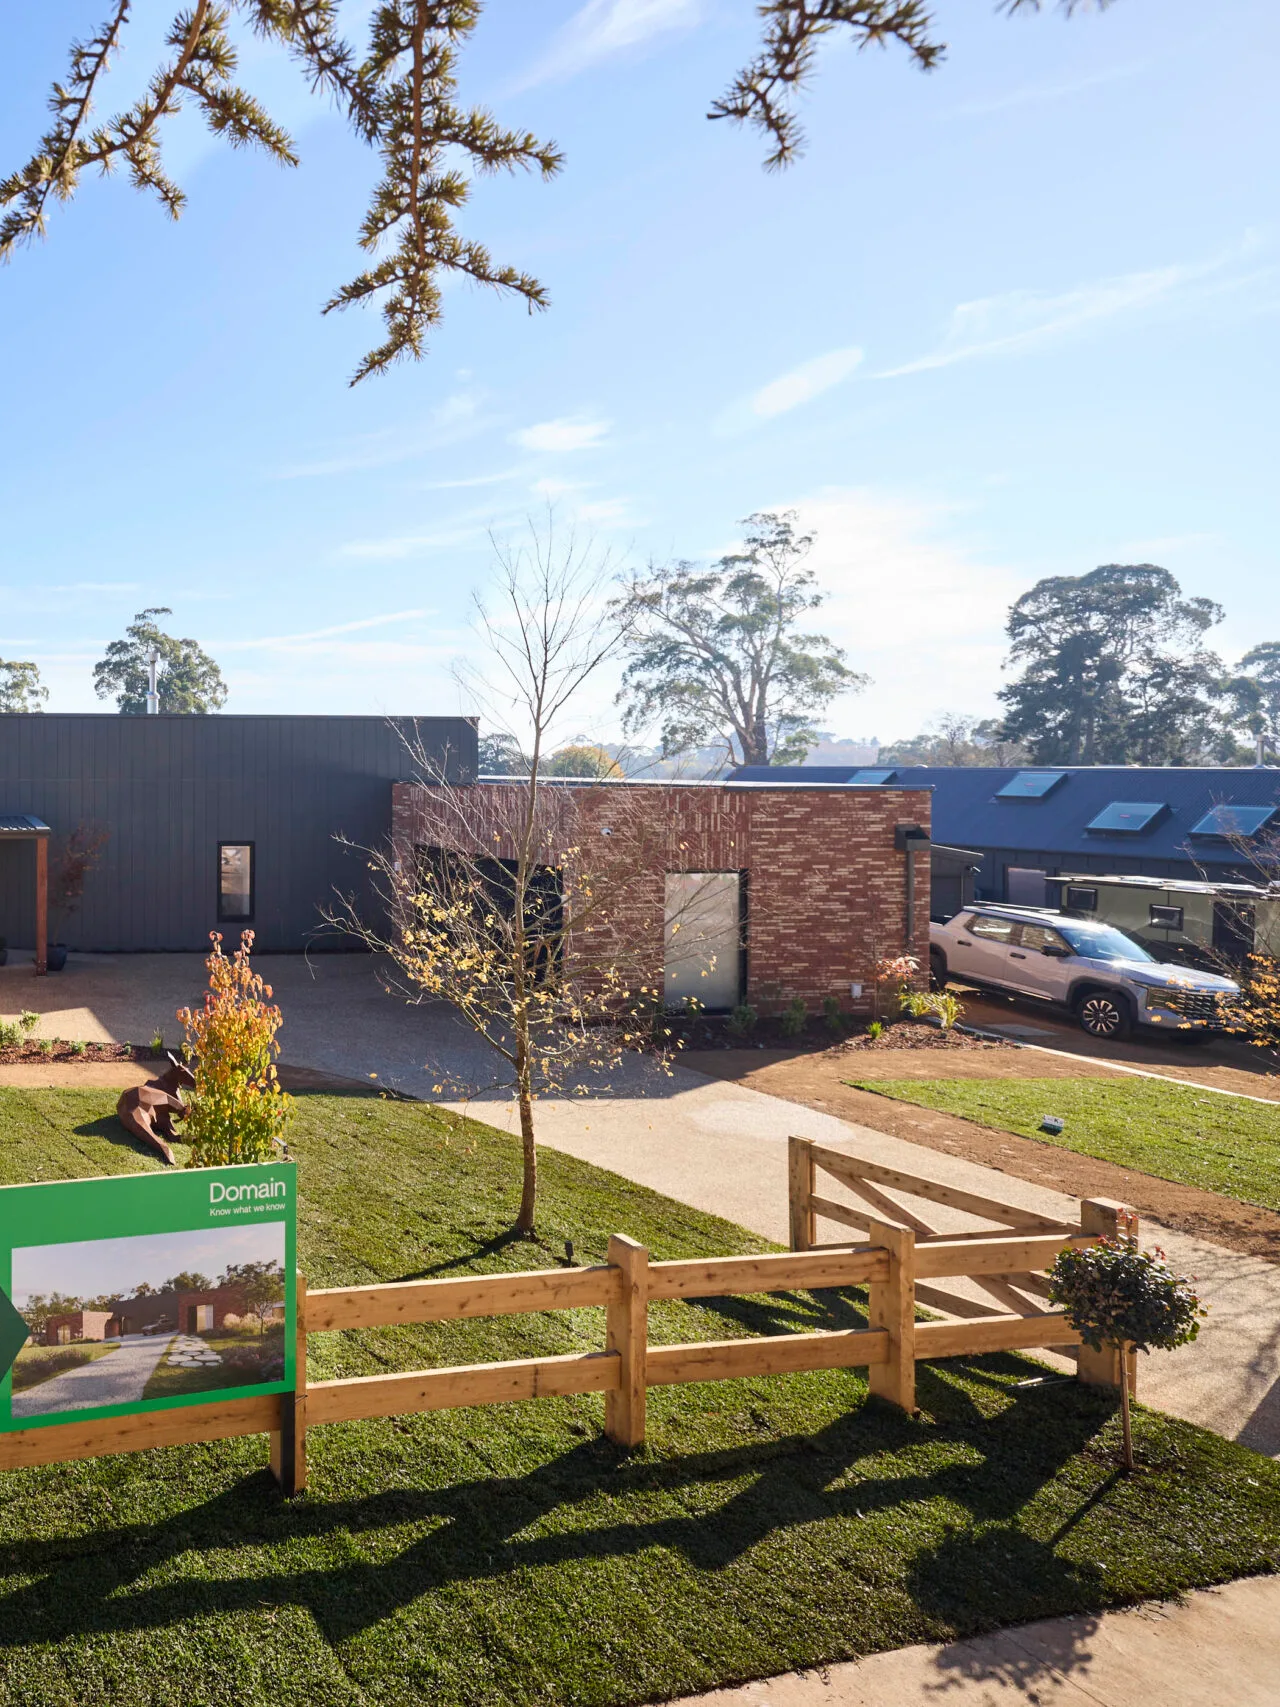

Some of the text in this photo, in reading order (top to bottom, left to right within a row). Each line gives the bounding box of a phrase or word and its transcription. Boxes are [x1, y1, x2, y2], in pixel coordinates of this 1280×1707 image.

[210, 1177, 286, 1203] Domain
[209, 1203, 286, 1217] Know what we know
